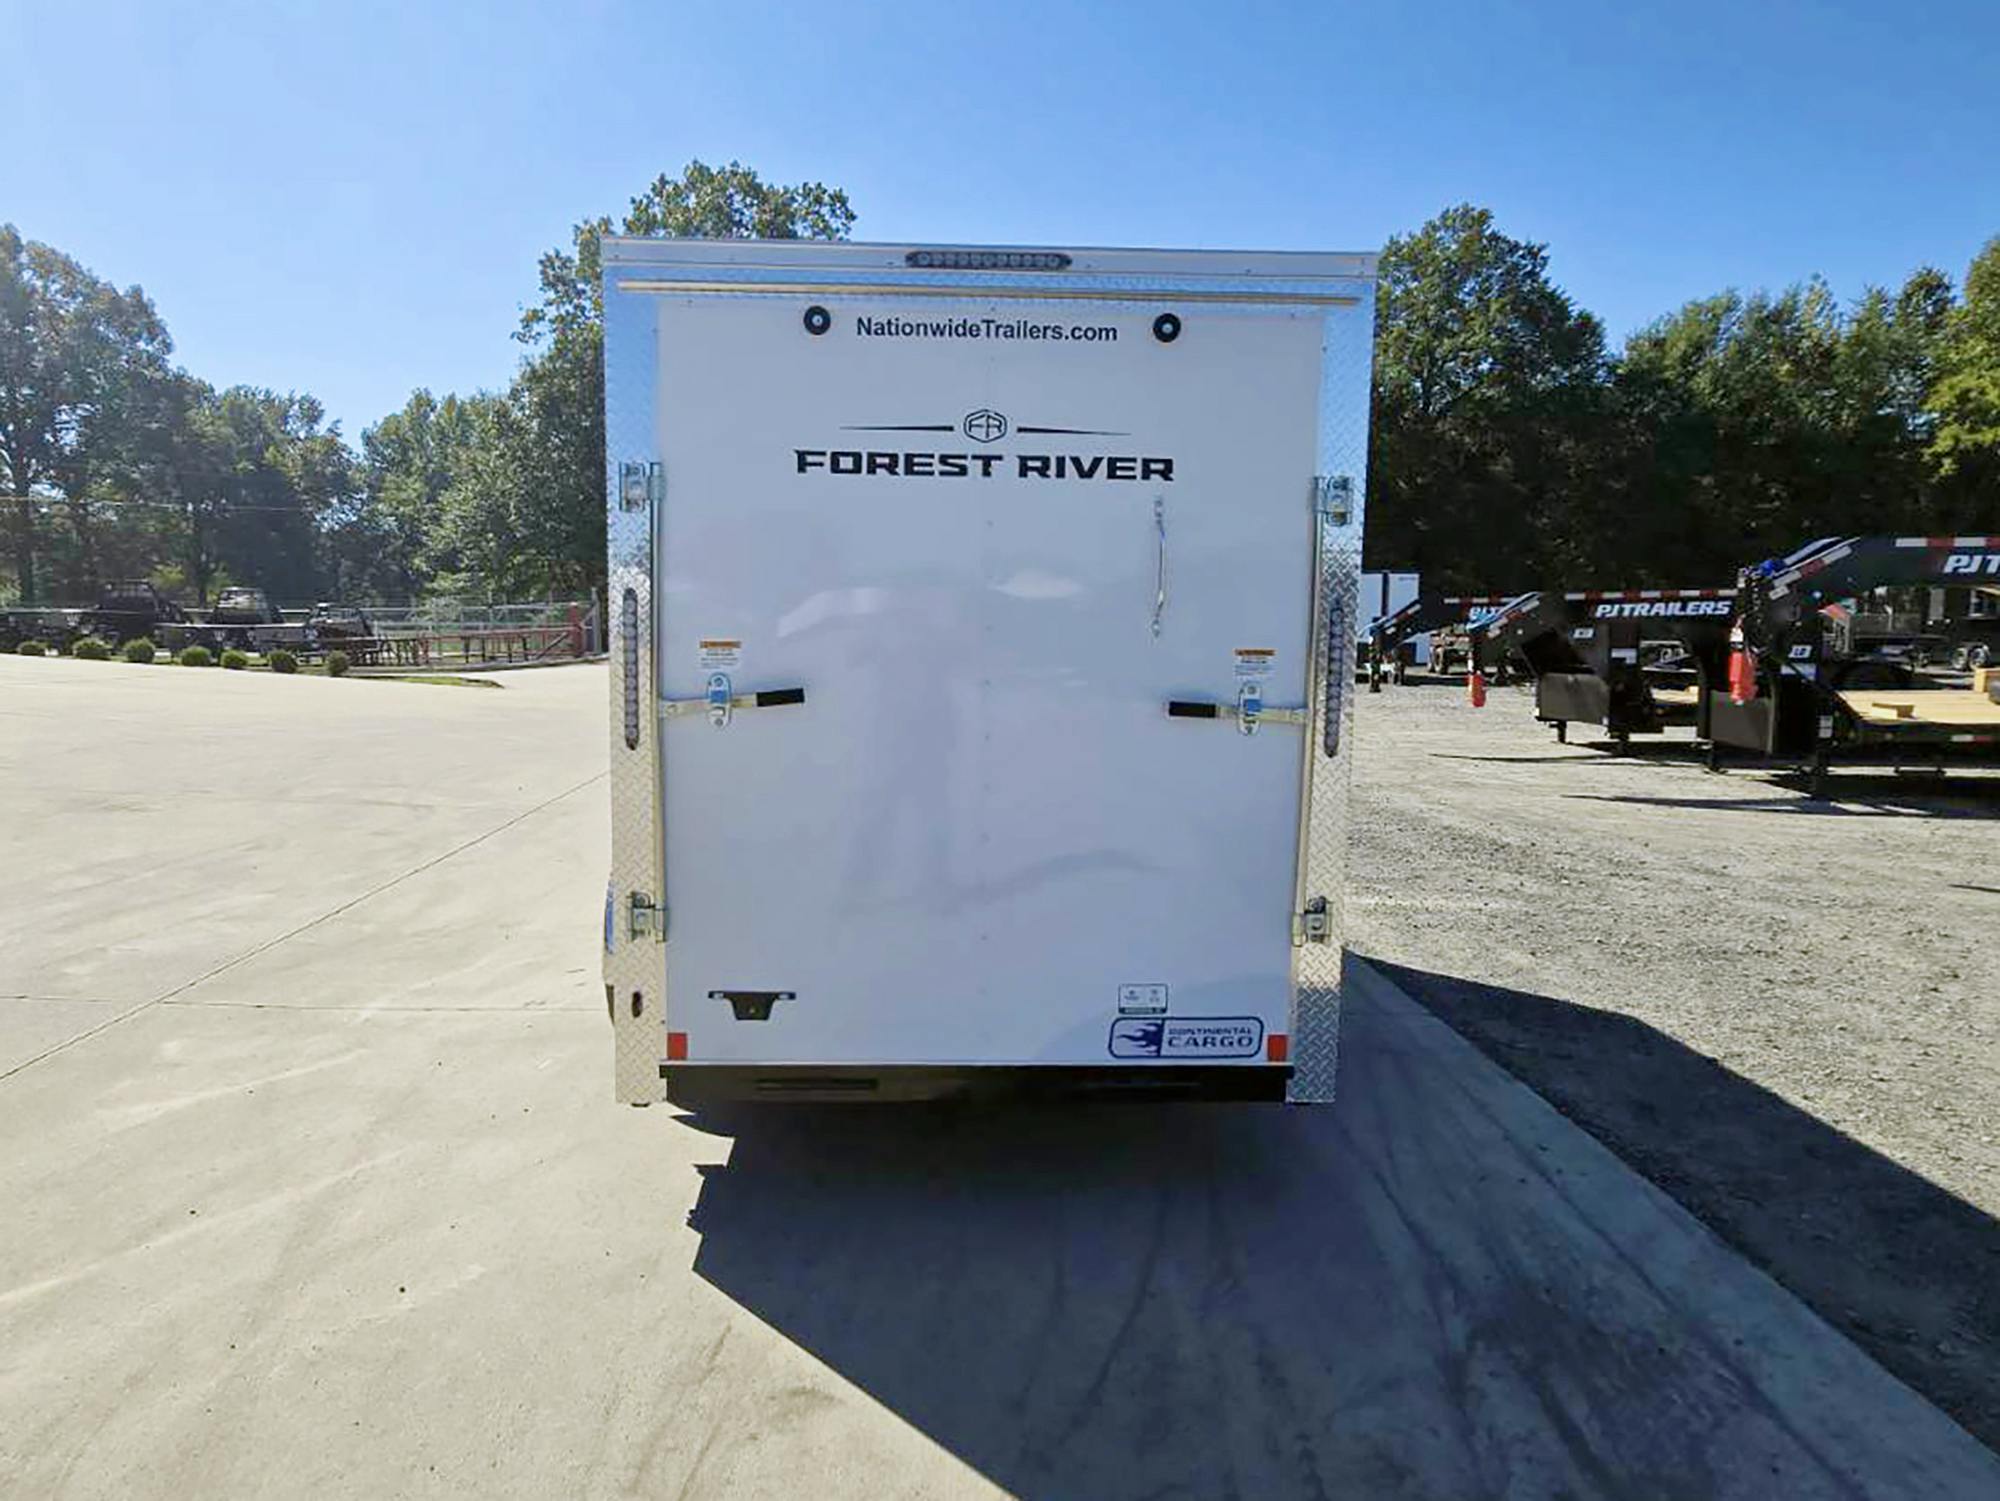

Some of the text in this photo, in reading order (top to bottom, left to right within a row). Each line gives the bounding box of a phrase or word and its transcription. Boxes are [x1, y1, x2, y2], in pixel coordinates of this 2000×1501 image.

[857, 317, 1118, 341] NationwideTrailers.com
[794, 449, 1174, 482] FOREST RIVER
[1168, 1036, 1253, 1048] CARGO
